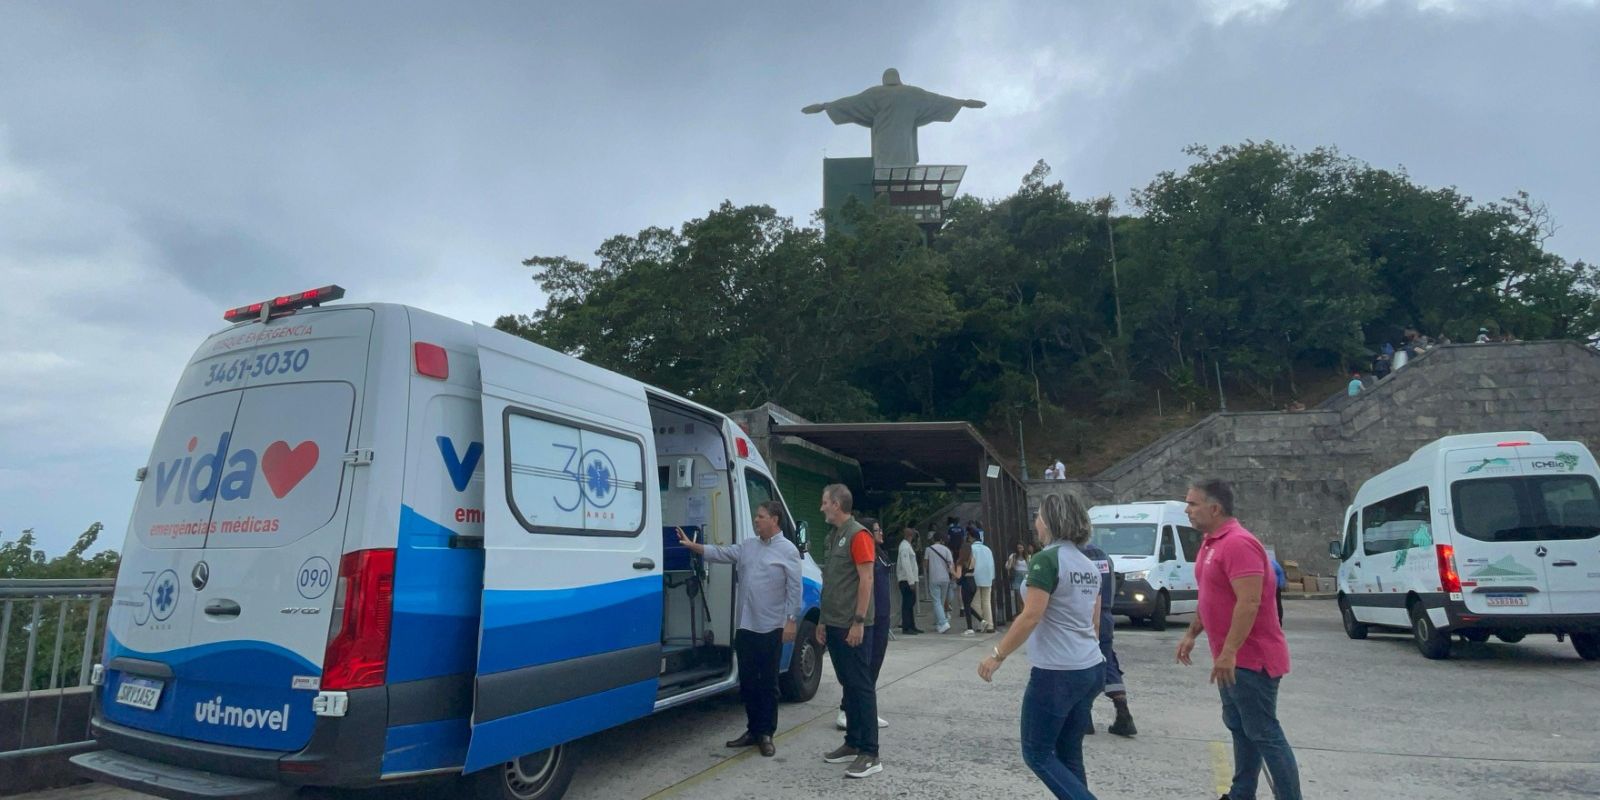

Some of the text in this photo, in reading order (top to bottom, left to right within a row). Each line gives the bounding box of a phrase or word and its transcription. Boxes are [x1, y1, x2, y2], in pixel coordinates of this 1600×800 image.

[204, 348, 310, 387] 3461-3030
[155, 431, 258, 508] vida
[220, 515, 280, 534] médicas
[300, 568, 329, 588] 090
[195, 695, 290, 732] uti-movel
